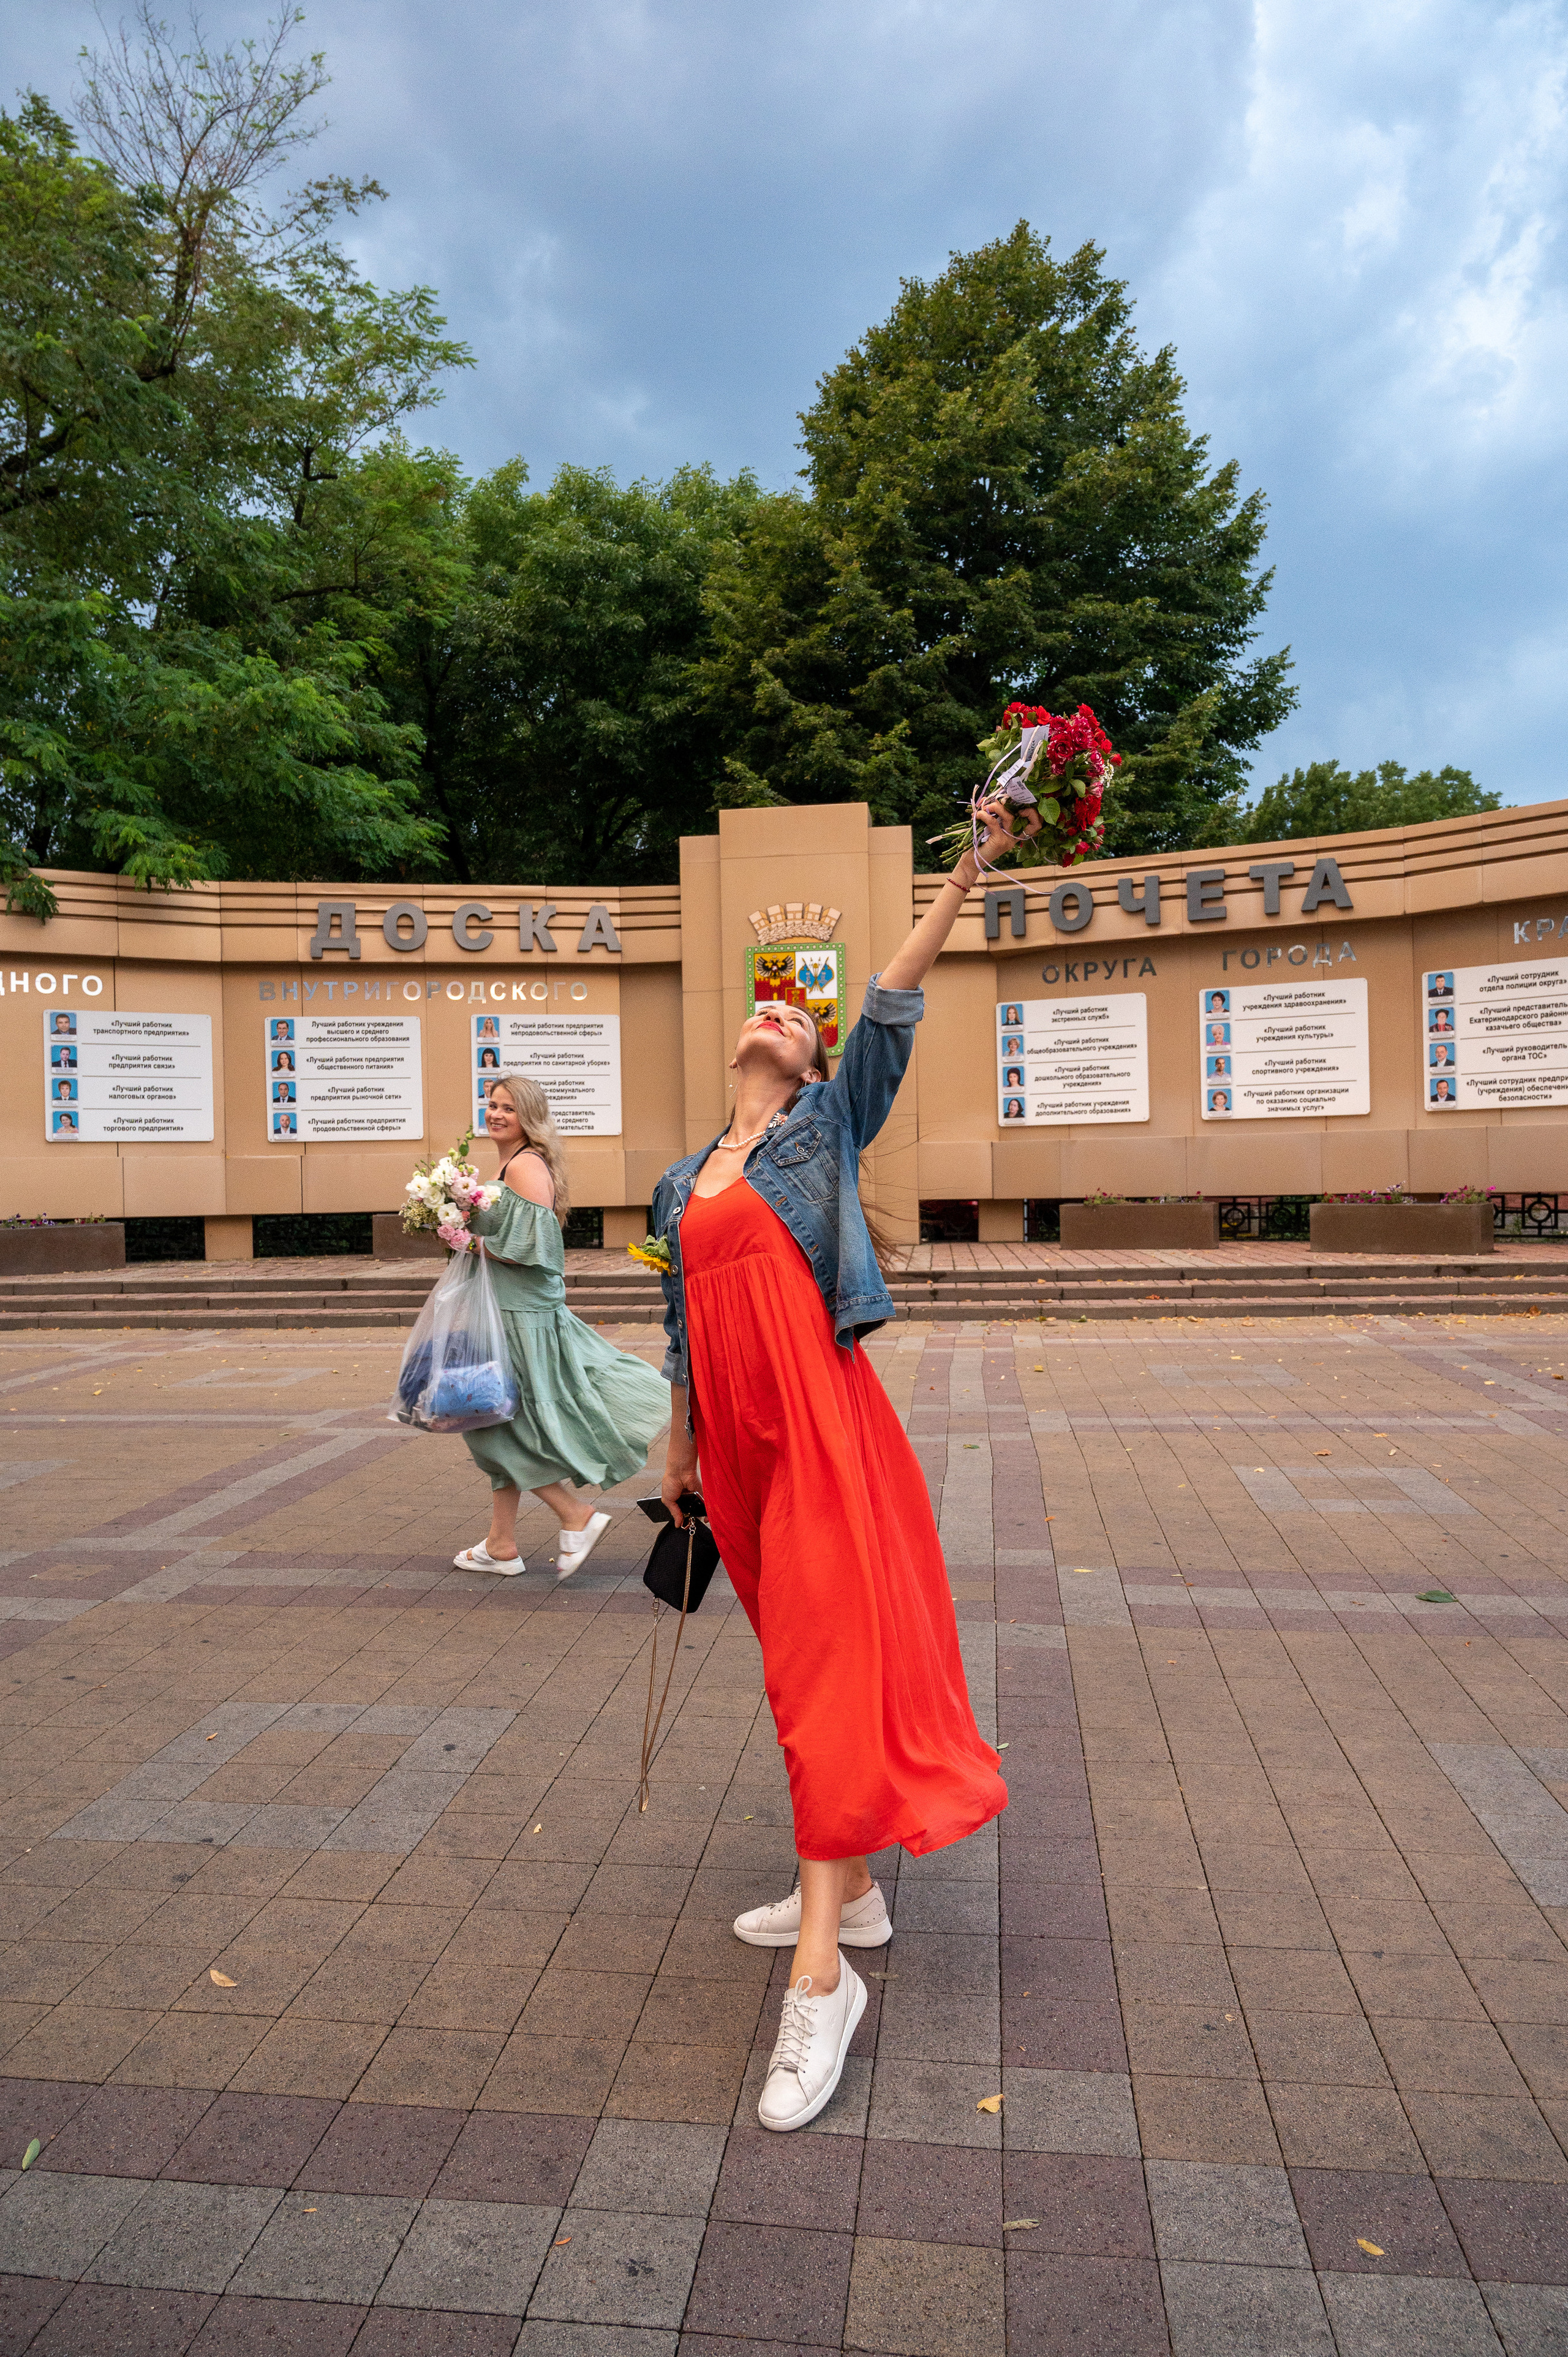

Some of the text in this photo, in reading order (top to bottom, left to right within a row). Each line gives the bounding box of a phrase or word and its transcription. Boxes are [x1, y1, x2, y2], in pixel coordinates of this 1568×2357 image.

[984, 858, 1354, 938] ПОЧЕТА
[311, 902, 622, 959] ДОСКА
[1042, 956, 1158, 984] ОКРУГА
[1222, 941, 1357, 971] ГОРОДА
[1487, 971, 1559, 983] «Лучший сотрудник
[258, 981, 588, 1004] ВНУТРИГОРОДСКОГО
[1264, 993, 1292, 1002] «Лучший
[1243, 999, 1346, 1012] учреждения здравоохранения»
[1480, 1002, 1568, 1015] «Лучший представитель
[1469, 1015, 1539, 1024] Екатеринодарского
[1264, 1026, 1293, 1034] «Лучший
[1027, 1046, 1096, 1054] общеобразовательного
[1482, 1043, 1567, 1055] «Лучший руководитель
[1466, 1078, 1497, 1087] «Лучший
[1477, 1086, 1525, 1095] (учреждения)
